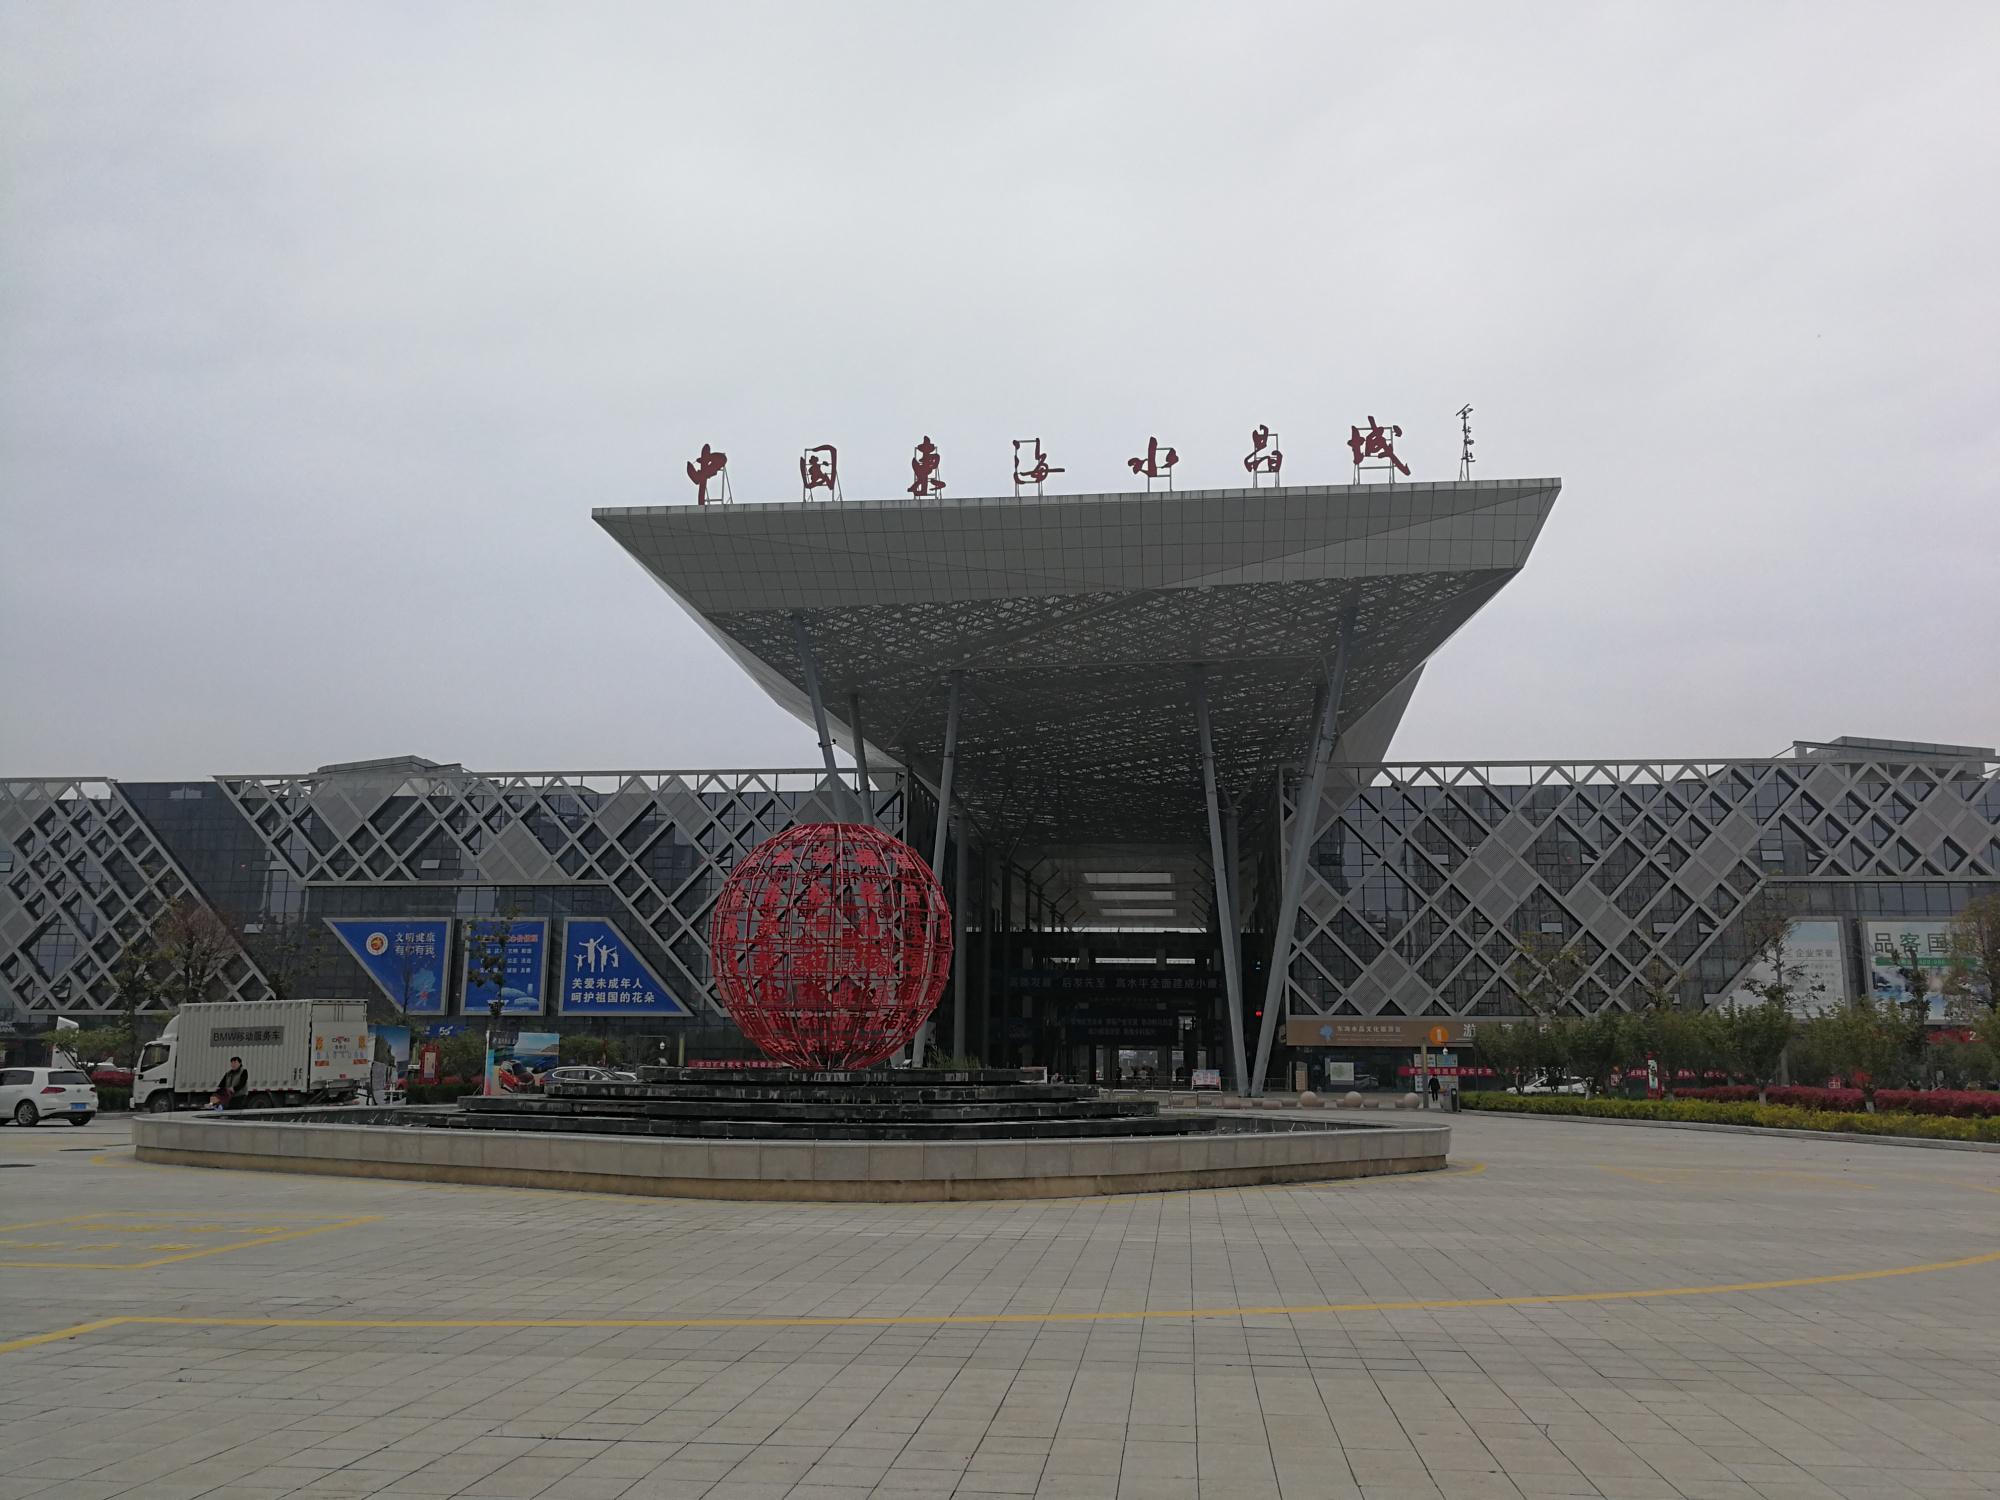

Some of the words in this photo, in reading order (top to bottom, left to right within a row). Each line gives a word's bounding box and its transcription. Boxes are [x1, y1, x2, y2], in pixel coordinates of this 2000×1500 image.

[572, 977, 643, 989] 关爱未成年人
[571, 991, 655, 1003] 呵护祖国的花朵
[213, 1030, 281, 1041] BMW移动服务车
